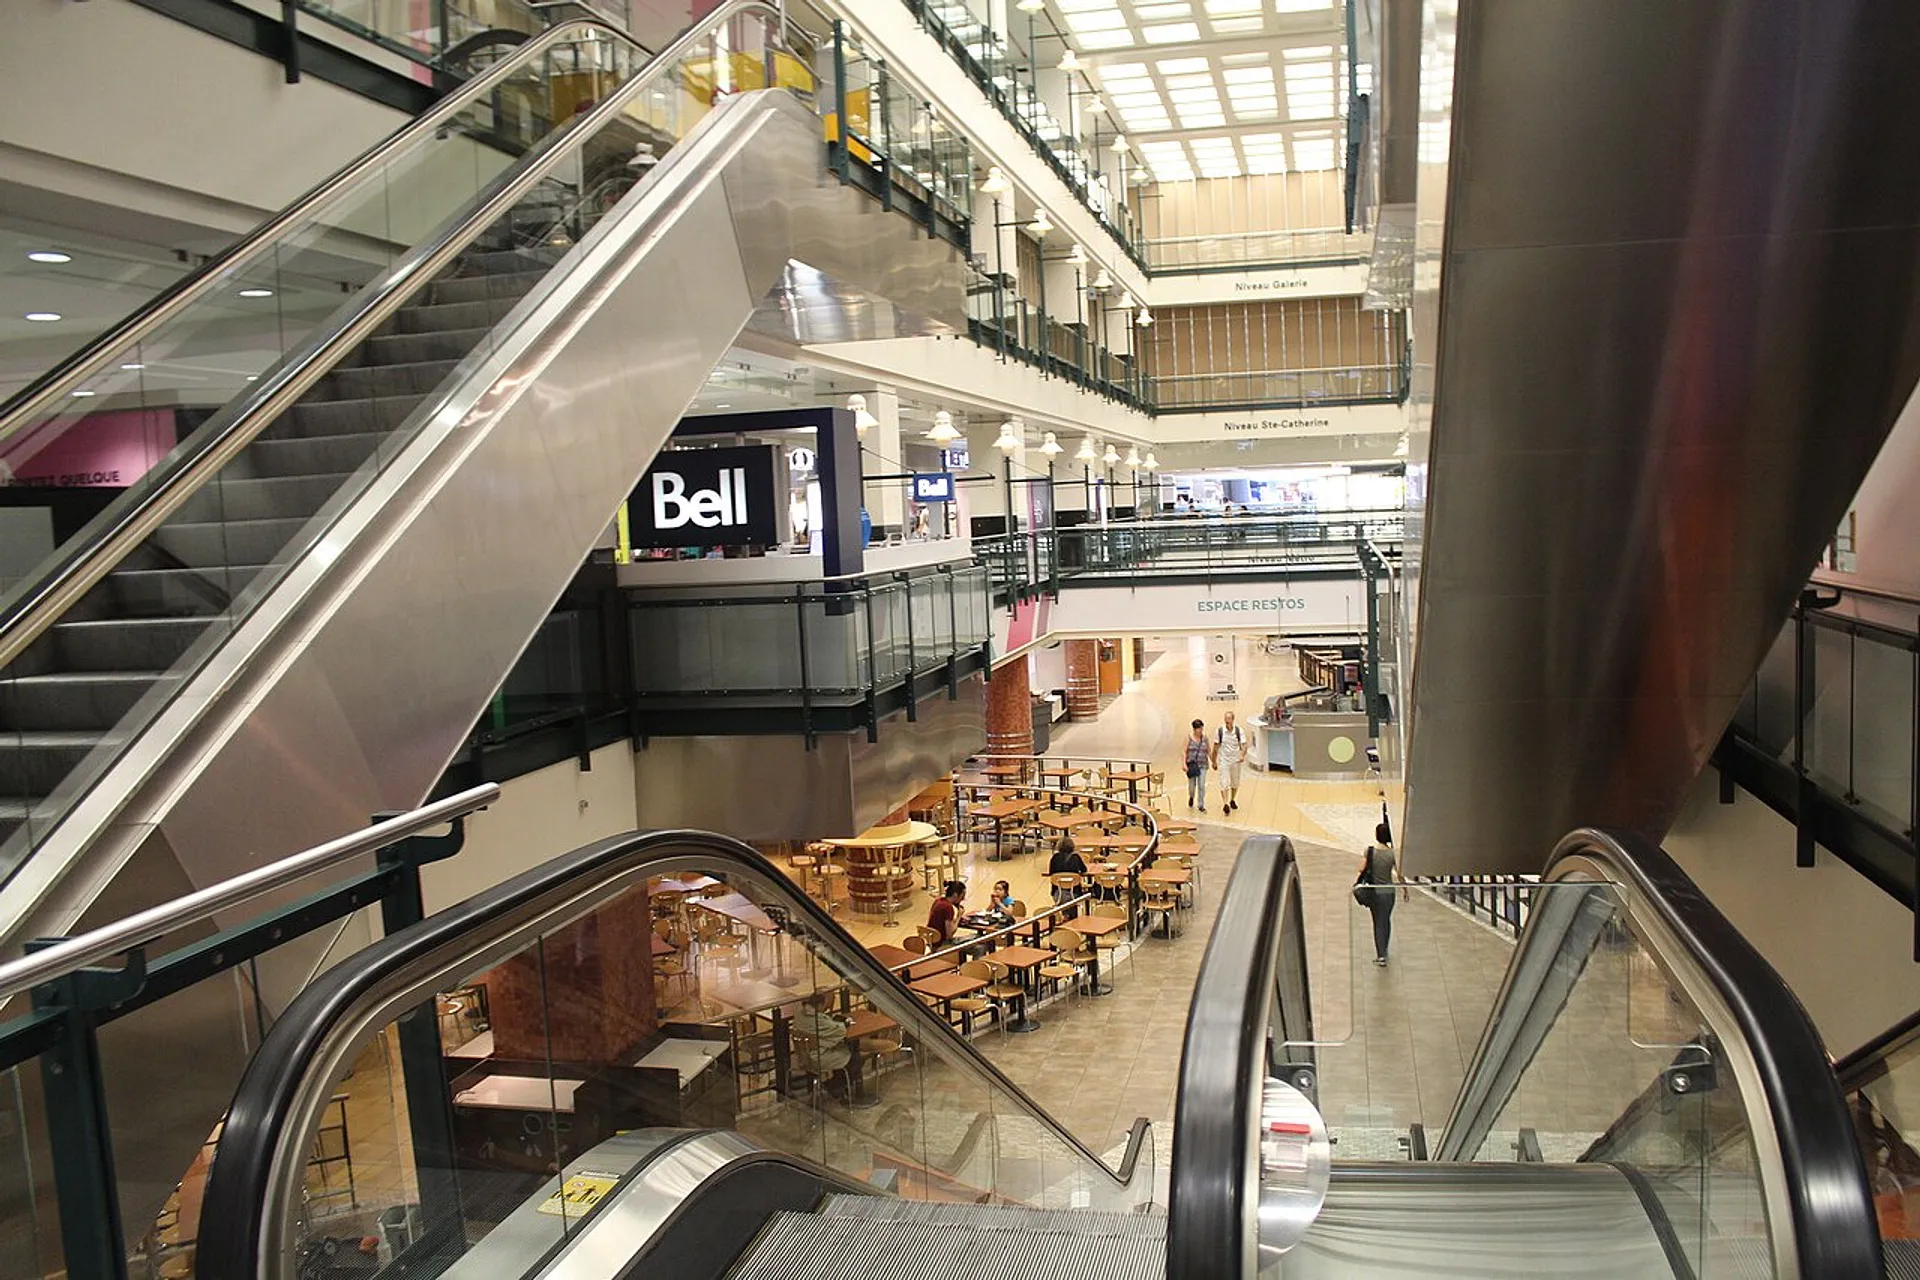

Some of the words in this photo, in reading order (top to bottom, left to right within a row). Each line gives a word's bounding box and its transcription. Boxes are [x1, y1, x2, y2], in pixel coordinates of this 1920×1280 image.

[1235, 282, 1269, 291] Niveau
[1273, 279, 1308, 289] Galerie
[1224, 421, 1258, 431] Niveau
[1262, 418, 1329, 429] Ste-Catherine
[652, 468, 747, 529] Bell
[1198, 600, 1248, 612] ESPACE
[1252, 598, 1305, 610] RESTOS
